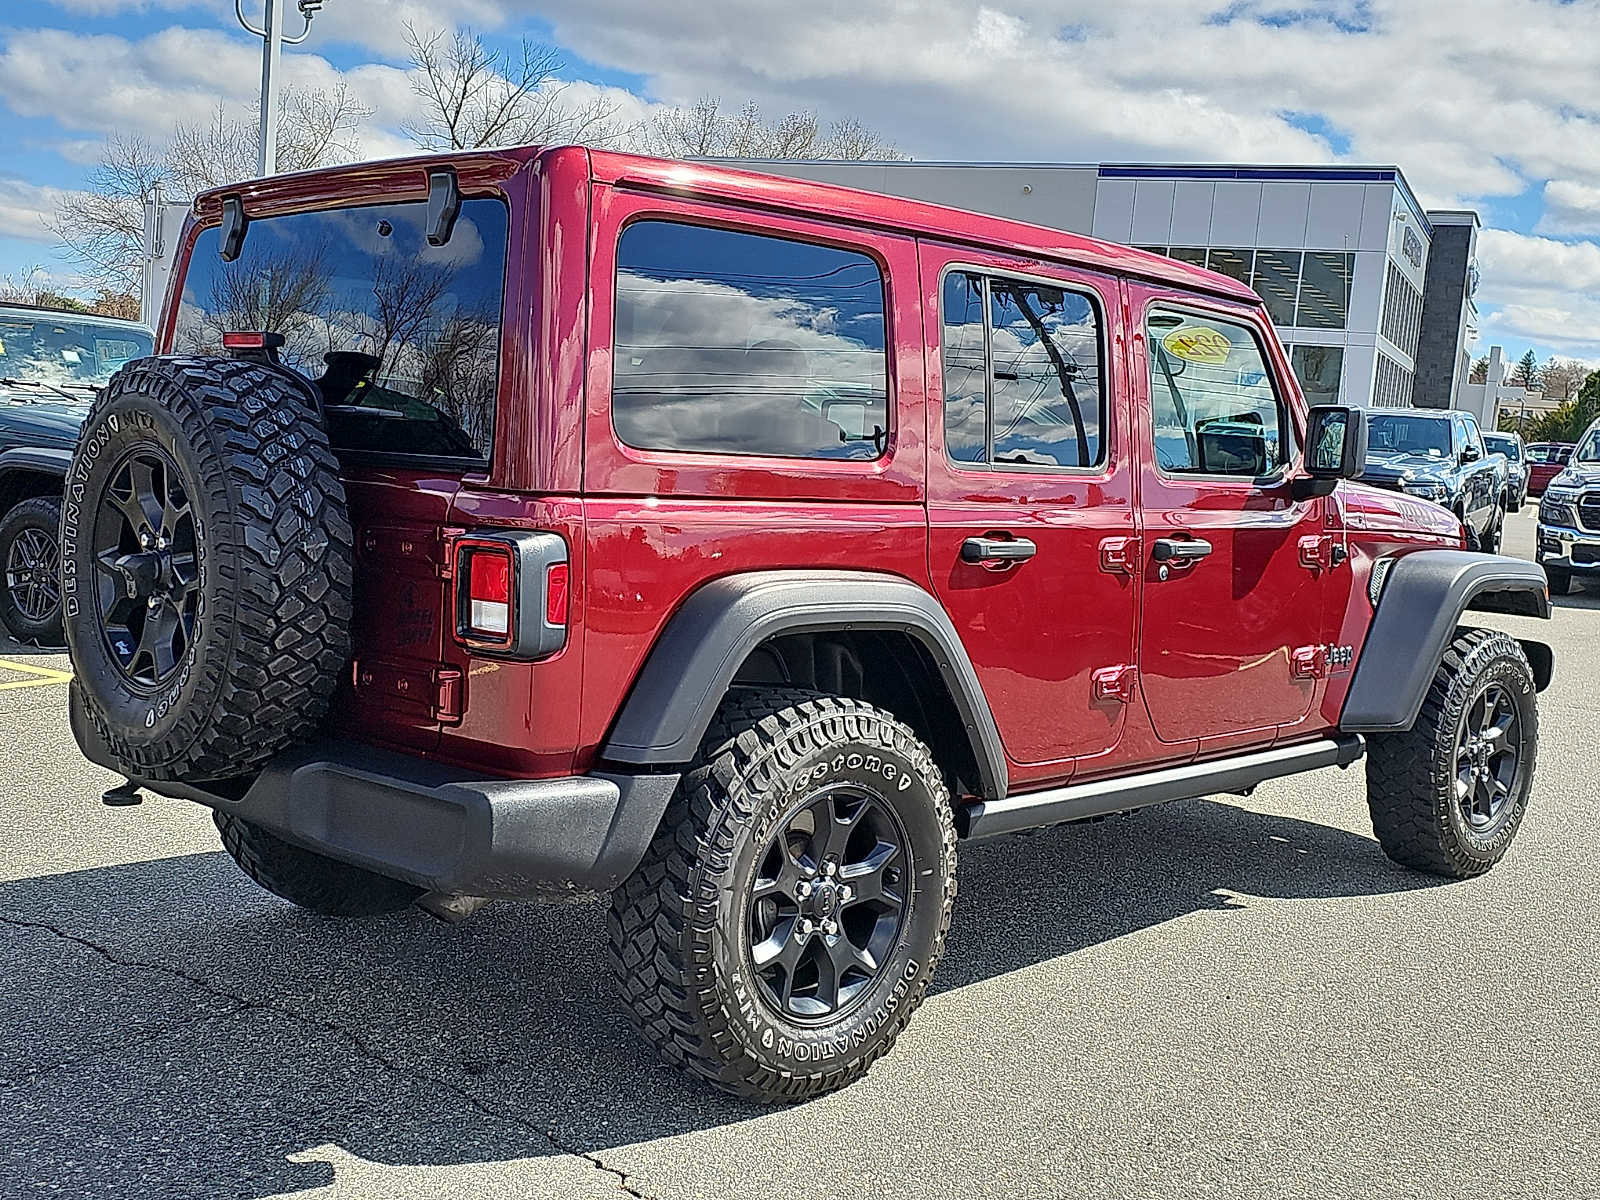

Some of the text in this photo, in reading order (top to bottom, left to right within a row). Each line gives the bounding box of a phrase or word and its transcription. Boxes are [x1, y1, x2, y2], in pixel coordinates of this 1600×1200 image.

[66, 428, 109, 617] DESTINATION
[1324, 642, 1353, 666] Jeep
[754, 753, 898, 844] Firestone
[776, 959, 919, 1061] DESTINATION
